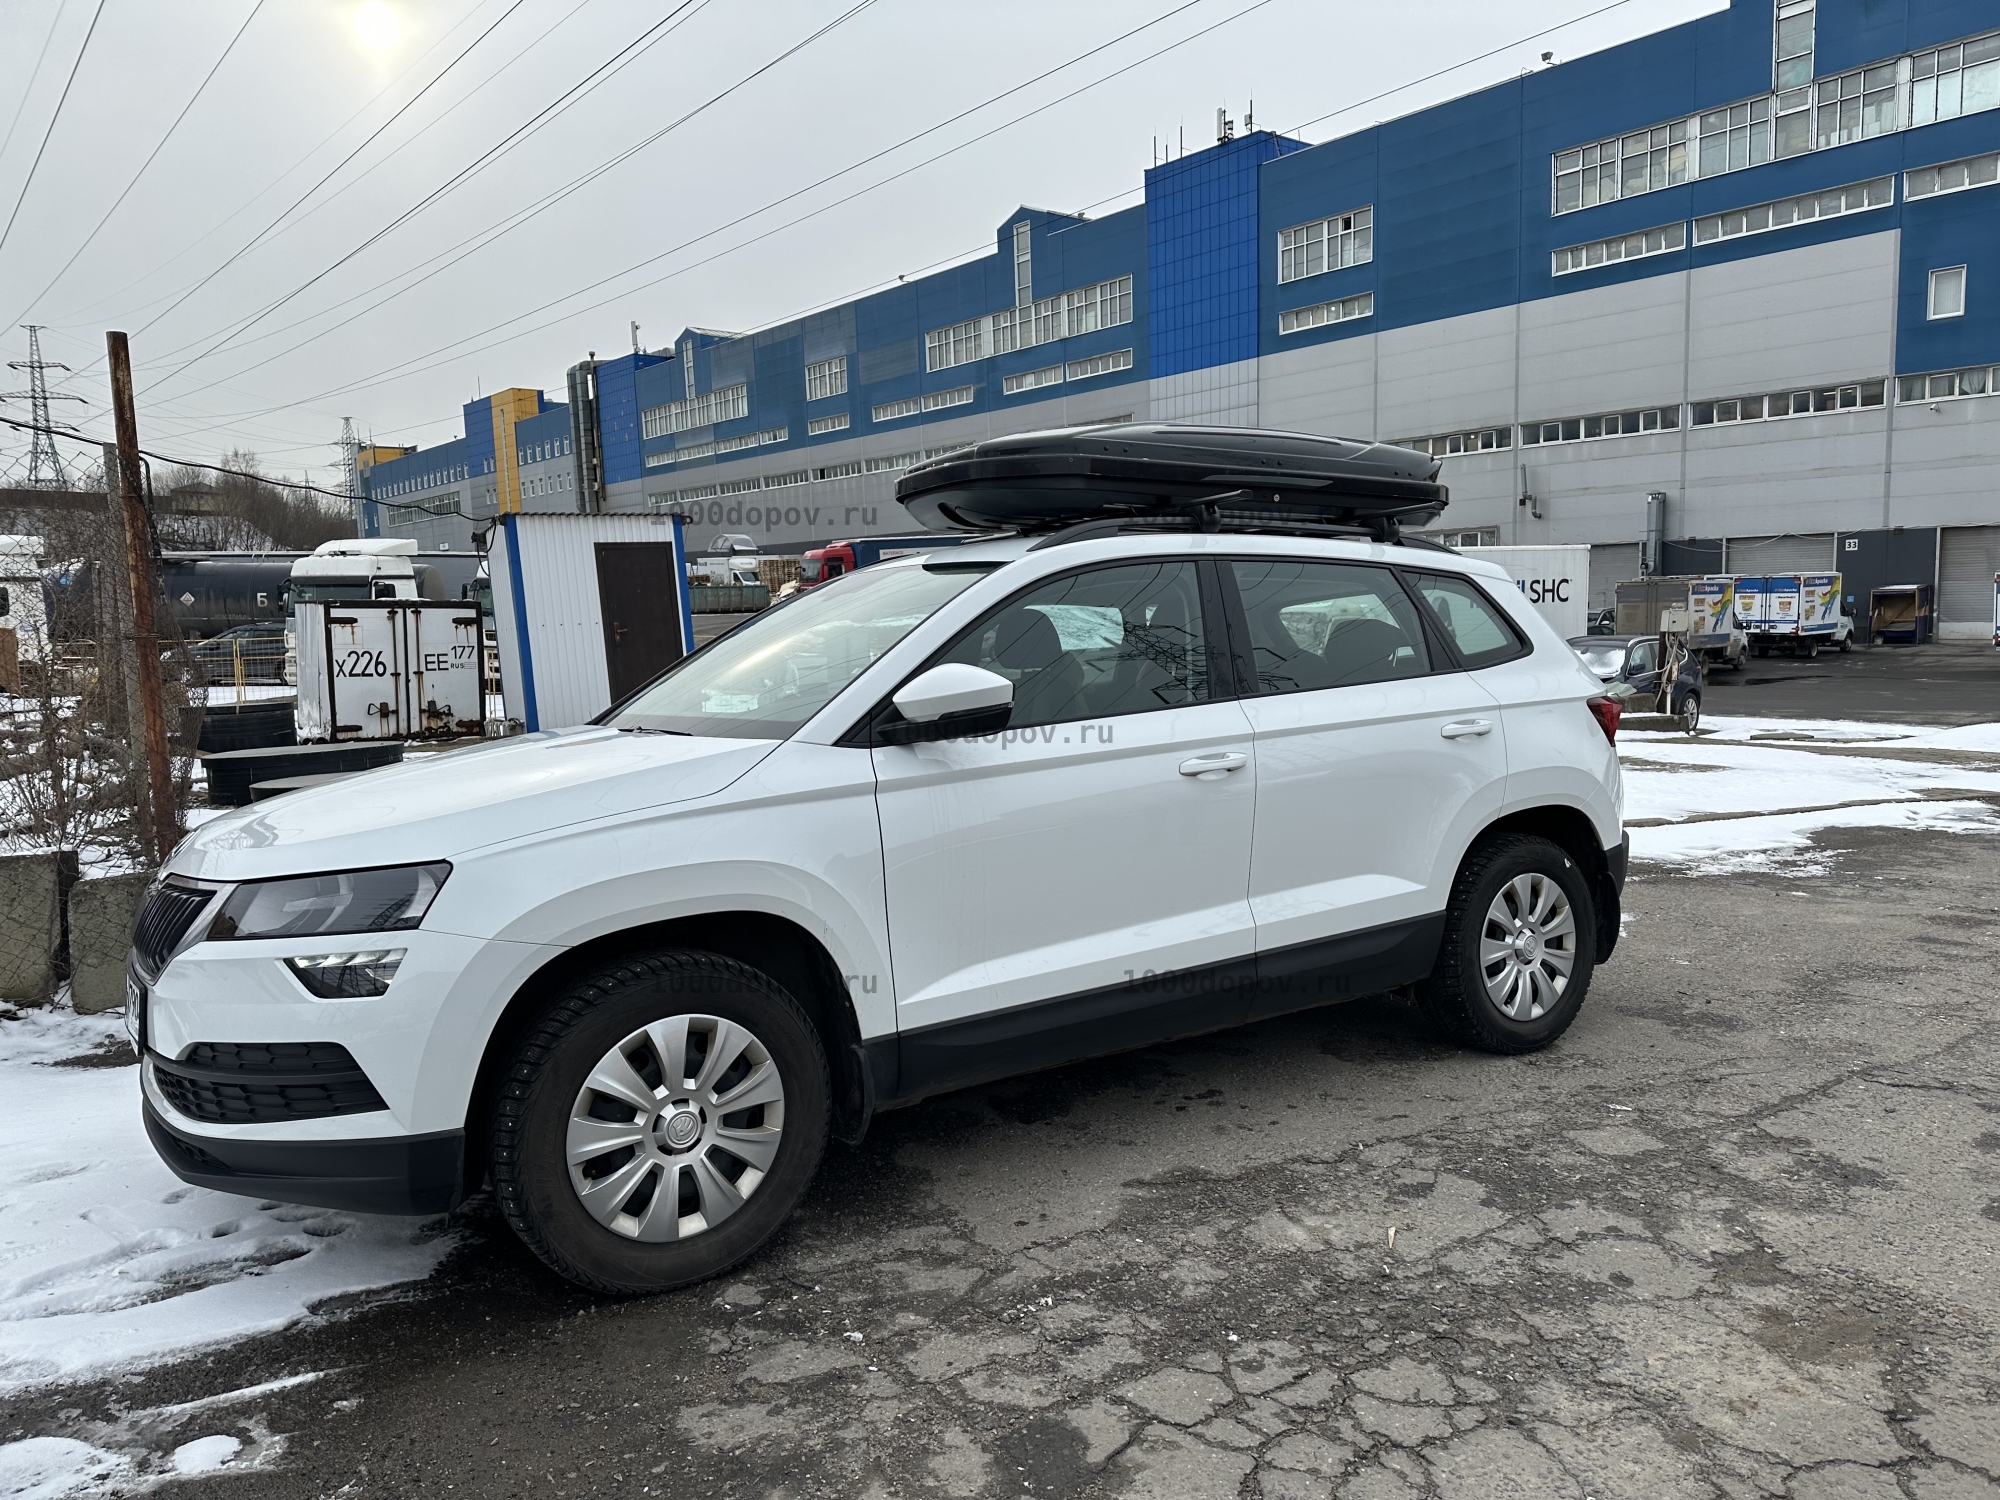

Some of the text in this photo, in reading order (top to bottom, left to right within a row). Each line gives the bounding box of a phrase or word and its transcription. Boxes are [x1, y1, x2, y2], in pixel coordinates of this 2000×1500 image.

[1846, 541, 1857, 549] 33
[1529, 579, 1569, 604] SHC
[450, 645, 475, 659] 177
